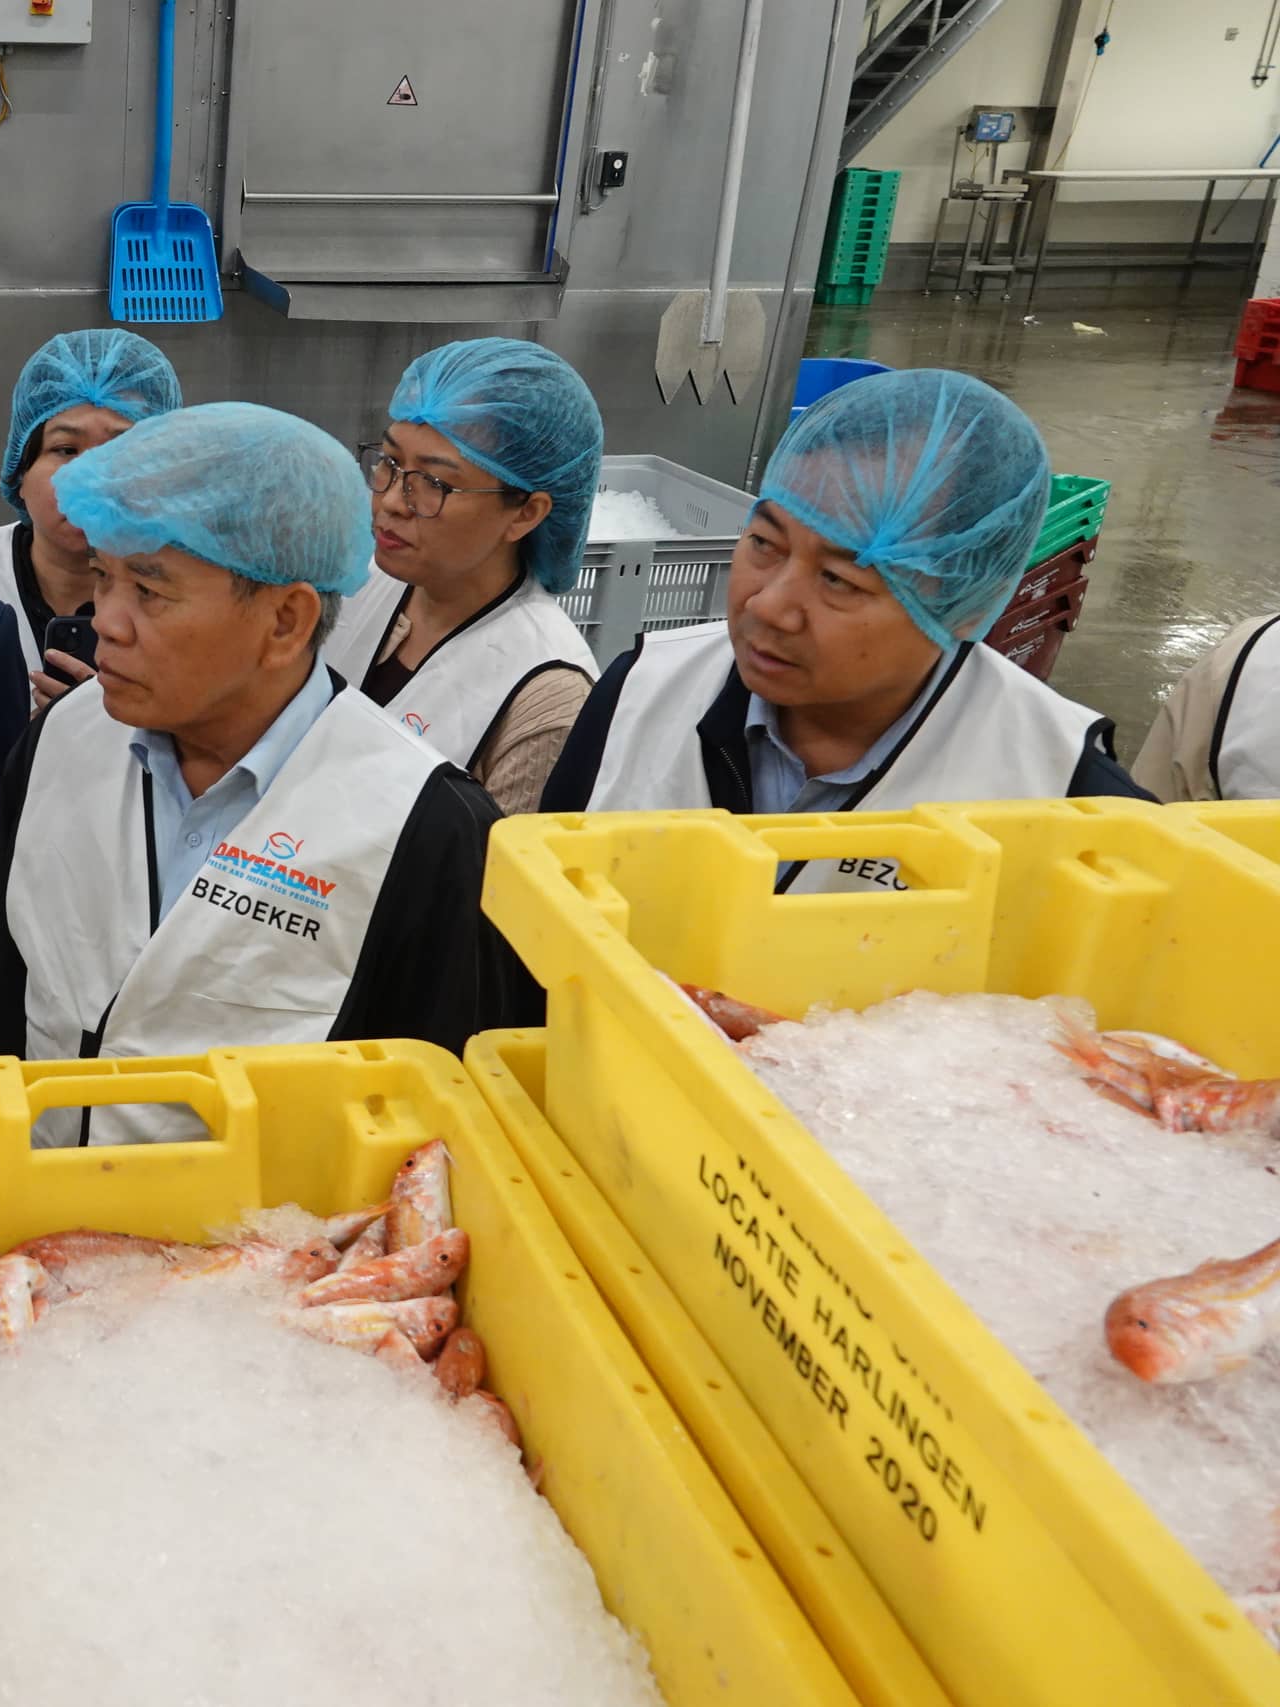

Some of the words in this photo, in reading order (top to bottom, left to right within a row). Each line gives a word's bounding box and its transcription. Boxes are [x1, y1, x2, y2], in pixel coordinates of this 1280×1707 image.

[192, 877, 321, 941] BEZOEKER
[213, 842, 337, 898] DAYSEADAY
[699, 1154, 801, 1298] LOCATIE
[813, 1295, 987, 1533] HARLINGEN
[714, 1233, 850, 1431] NOVEMBER
[866, 1436, 938, 1542] 2020
